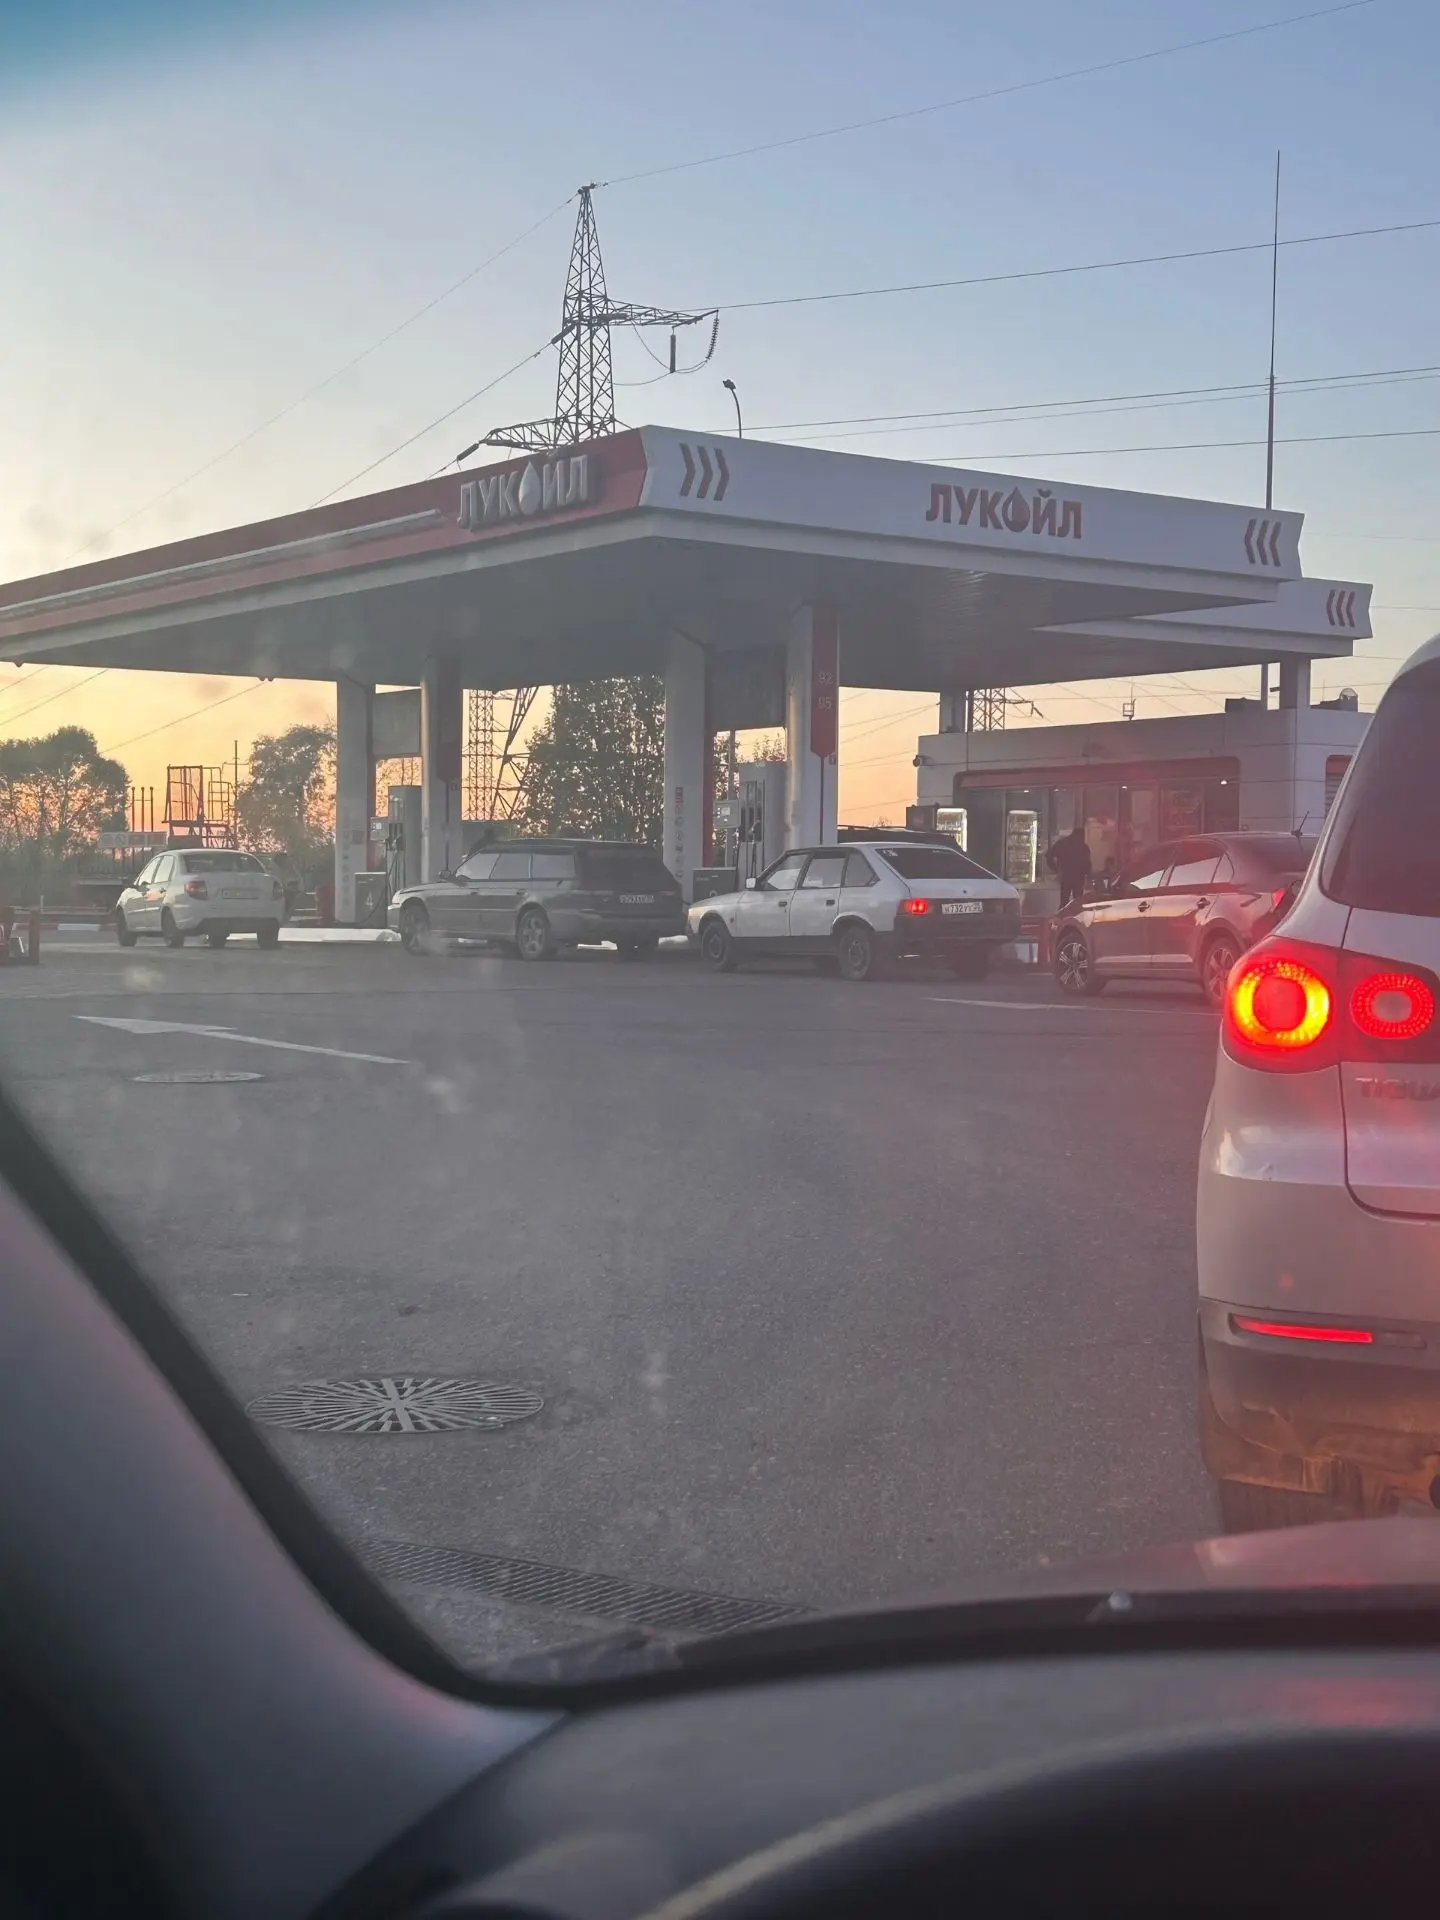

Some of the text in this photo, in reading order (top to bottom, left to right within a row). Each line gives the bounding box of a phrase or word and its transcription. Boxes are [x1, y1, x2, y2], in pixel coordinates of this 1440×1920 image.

[457, 449, 589, 530] ЛУКОЙЛ
[925, 483, 1083, 539] ЛУКОЙЛ
[818, 696, 833, 710] 95
